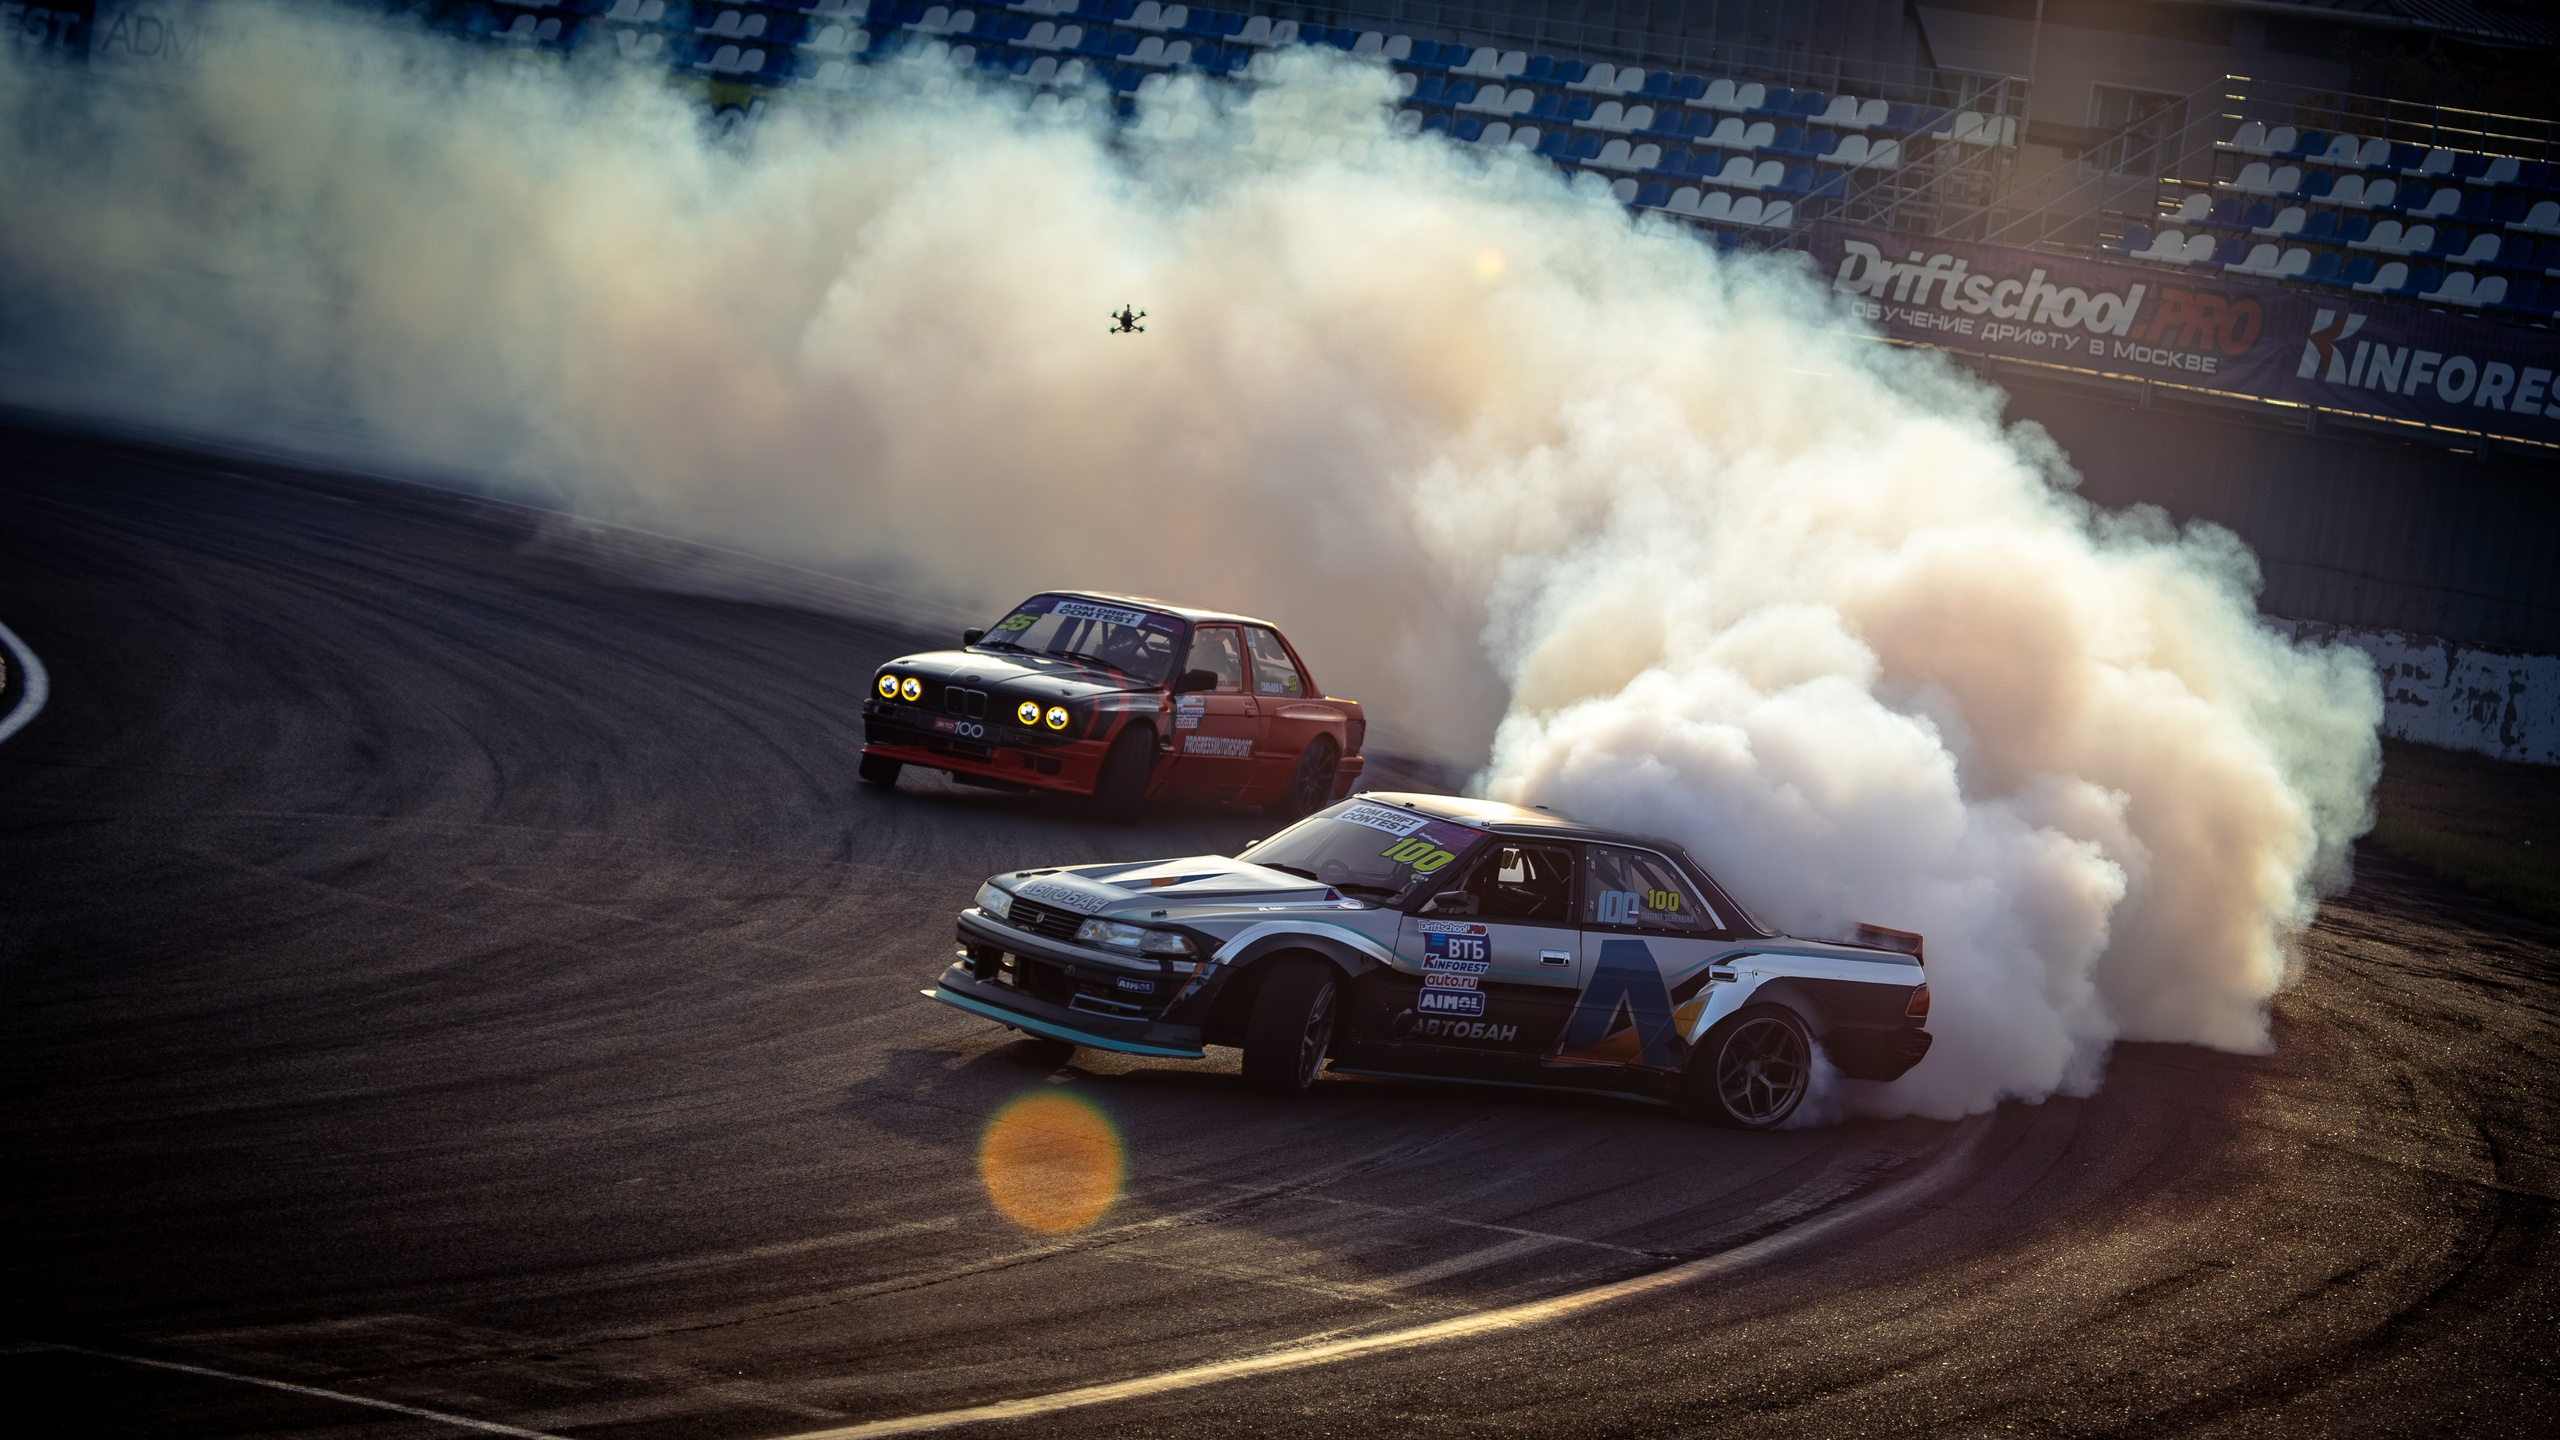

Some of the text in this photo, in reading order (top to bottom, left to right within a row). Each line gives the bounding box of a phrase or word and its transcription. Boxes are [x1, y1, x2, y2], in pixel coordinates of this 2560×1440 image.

[101, 11, 202, 63] ADM
[1851, 302, 1973, 335] ОБУЧЕНИЕ
[1981, 321, 2080, 352] ДРИФТУ
[2089, 339, 2105, 356] В
[1058, 608, 1136, 625] CONTEST
[1062, 603, 1140, 619] ADM DRIFT
[955, 720, 984, 738] 100
[1341, 812, 1411, 833] CONTEST
[1351, 806, 1421, 826] ADM DRIFT
[1379, 837, 1456, 874] 100
[1020, 881, 1112, 914] АВТОБАН
[1596, 889, 1641, 925] 100
[1648, 889, 1680, 912] 100
[1448, 938, 1485, 960] ВТБ
[1422, 954, 1488, 973] KINFOREST
[1118, 979, 1151, 992] AIMOL
[1426, 974, 1477, 989] auto.ru
[1420, 993, 1481, 1012] AIMOL
[1410, 1018, 1518, 1042] АВТОБАН
